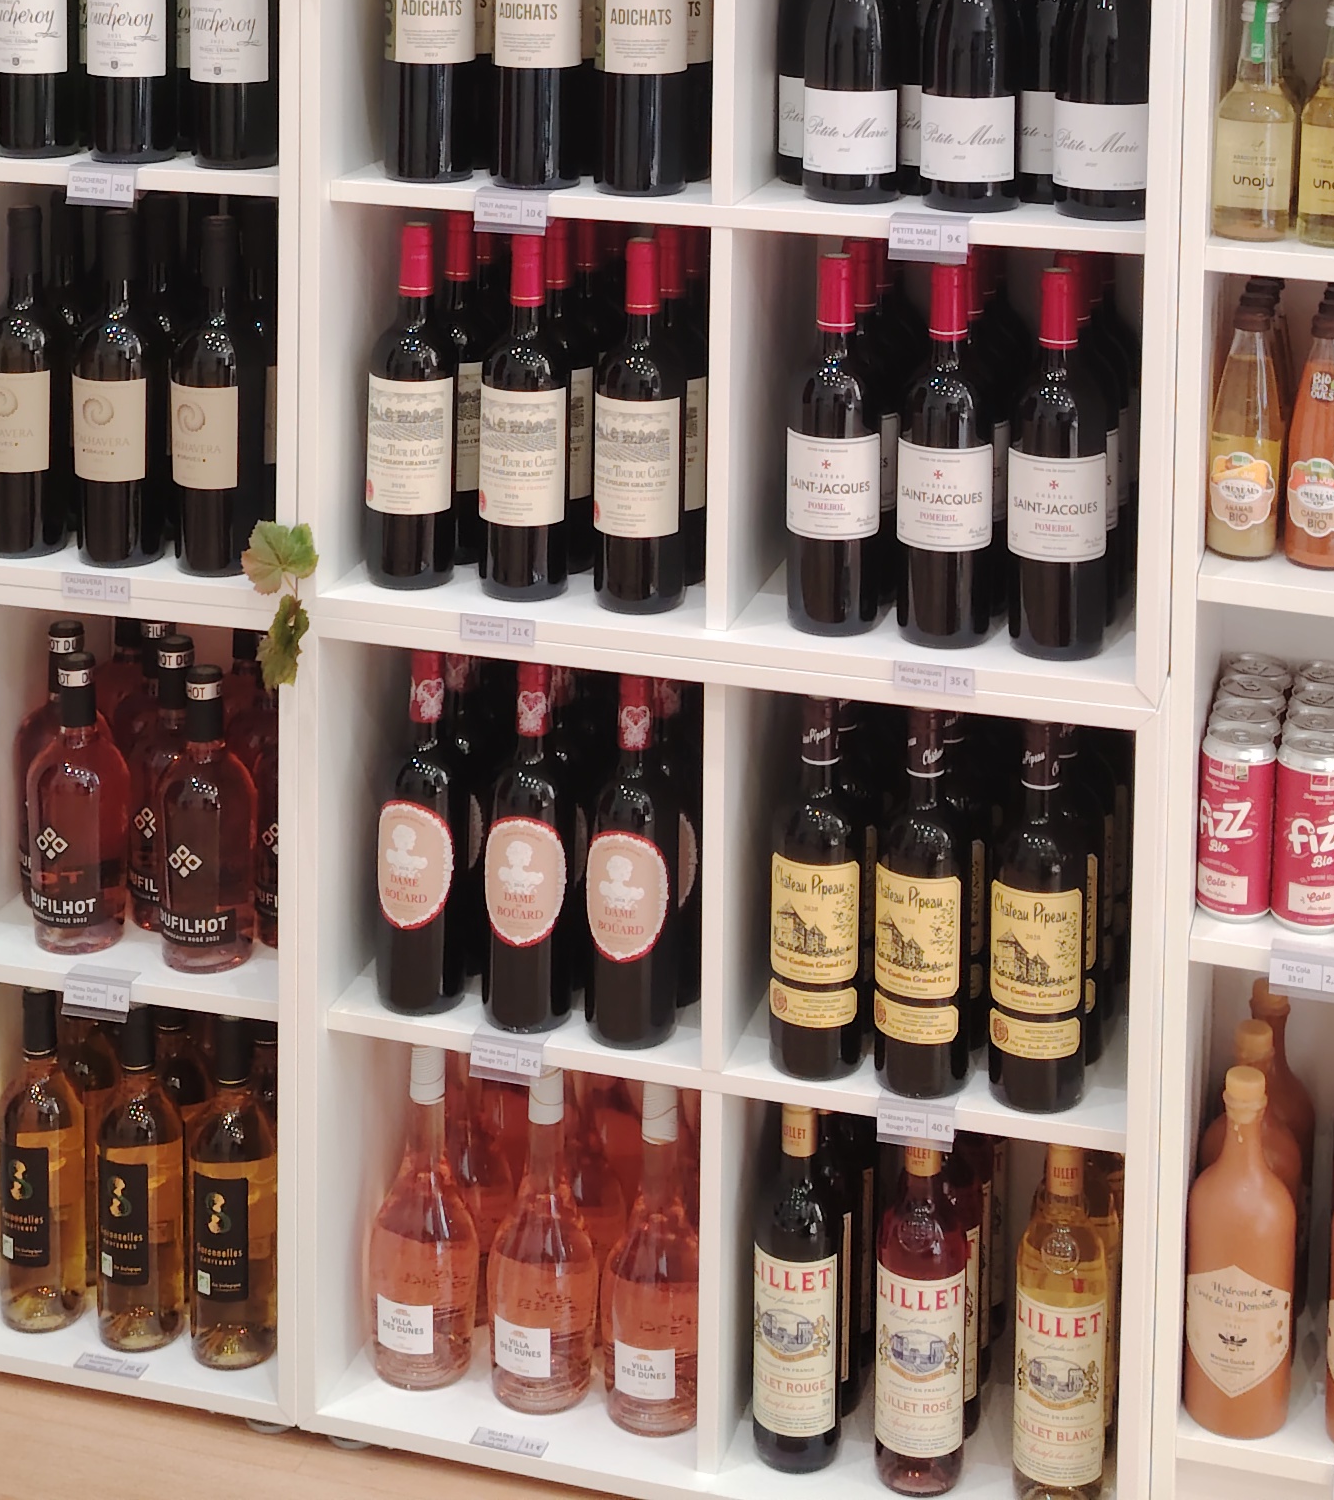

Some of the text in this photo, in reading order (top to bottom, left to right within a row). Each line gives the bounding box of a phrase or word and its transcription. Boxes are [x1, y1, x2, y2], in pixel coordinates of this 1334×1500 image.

[401, 0, 462, 16] ADICHATS
[499, 3, 558, 20] ADICHATS
[610, 8, 672, 25] ADICHATS
[807, 115, 889, 139] Petite Marie
[922, 122, 1006, 145] Petite Marie
[1232, 174, 1275, 190] unaju
[902, 486, 983, 505] SAINT-JACQUES
[808, 502, 845, 512] POMEROL
[1014, 496, 1098, 515] SAINT-JACQUES
[920, 511, 958, 522] POMEROL
[950, 676, 960, 686] 35
[1311, 855, 1334, 868] Bio
[504, 892, 535, 904] DAME
[1307, 890, 1331, 902] Cola
[1034, 902, 1067, 931] Pipeau
[879, 1280, 962, 1312] LILLET
[391, 1316, 413, 1328] VILLA
[1018, 1299, 1101, 1338] LILLET
[382, 1319, 424, 1335] DES DUNES
[508, 1338, 529, 1349] VILLA
[622, 1365, 666, 1380] DES DUNES
[786, 1379, 827, 1392] ROUGE
[1056, 1428, 1095, 1442] BLANC
